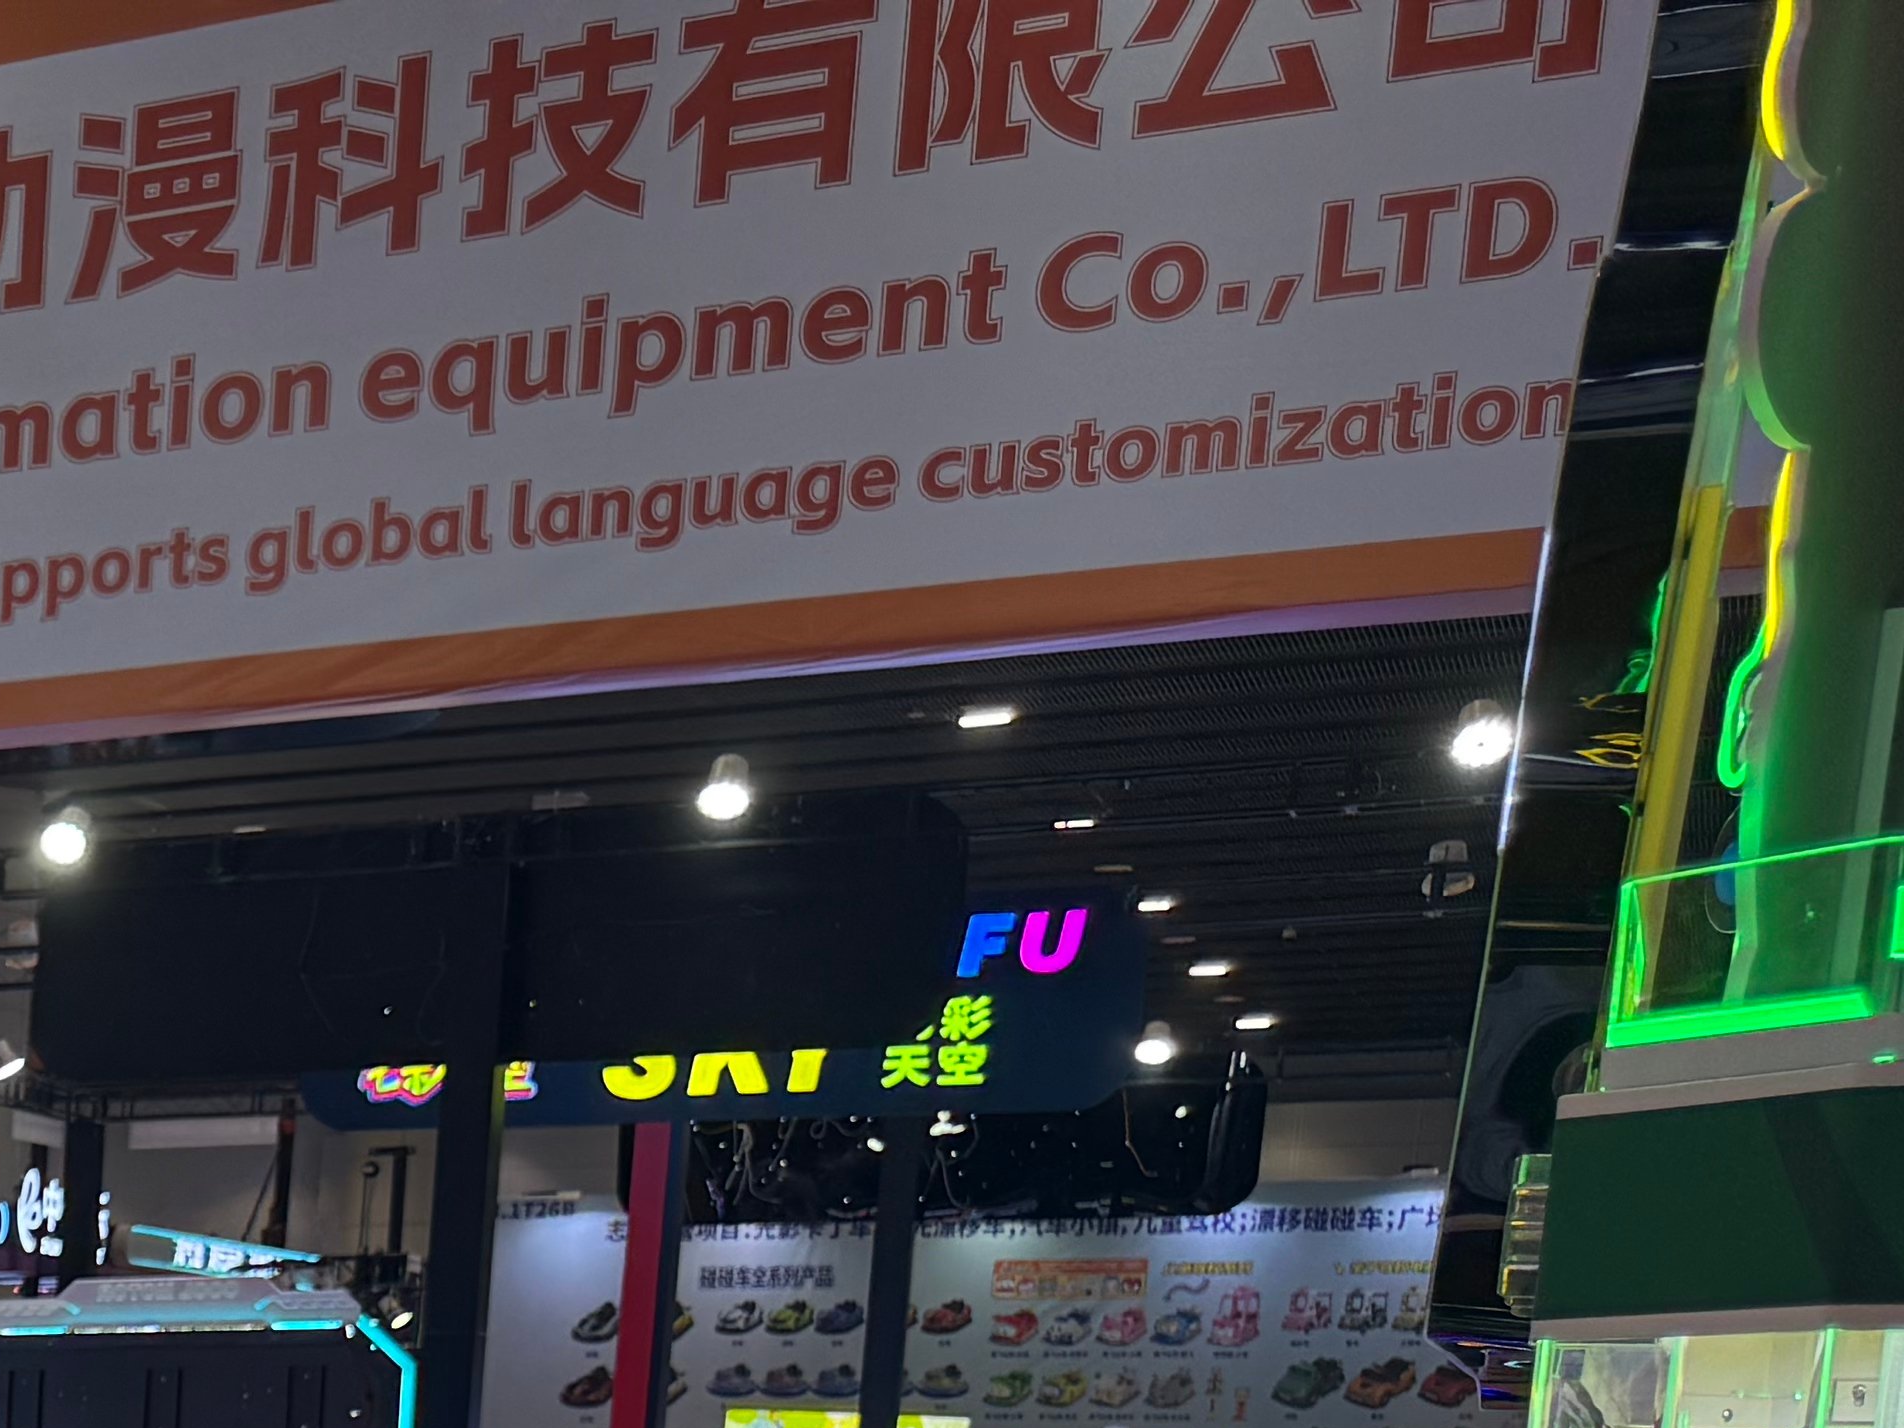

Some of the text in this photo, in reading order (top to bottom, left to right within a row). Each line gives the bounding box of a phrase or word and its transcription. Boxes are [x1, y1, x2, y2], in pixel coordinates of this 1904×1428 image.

[361, 246, 1006, 436] equipment
[1035, 176, 1605, 335] Co.,LTD.
[244, 486, 489, 597] global
[509, 453, 902, 552] language
[915, 371, 1570, 505] customization
[955, 907, 1088, 979] FU
[915, 994, 993, 1042] 彩
[880, 1041, 988, 1090] 天空
